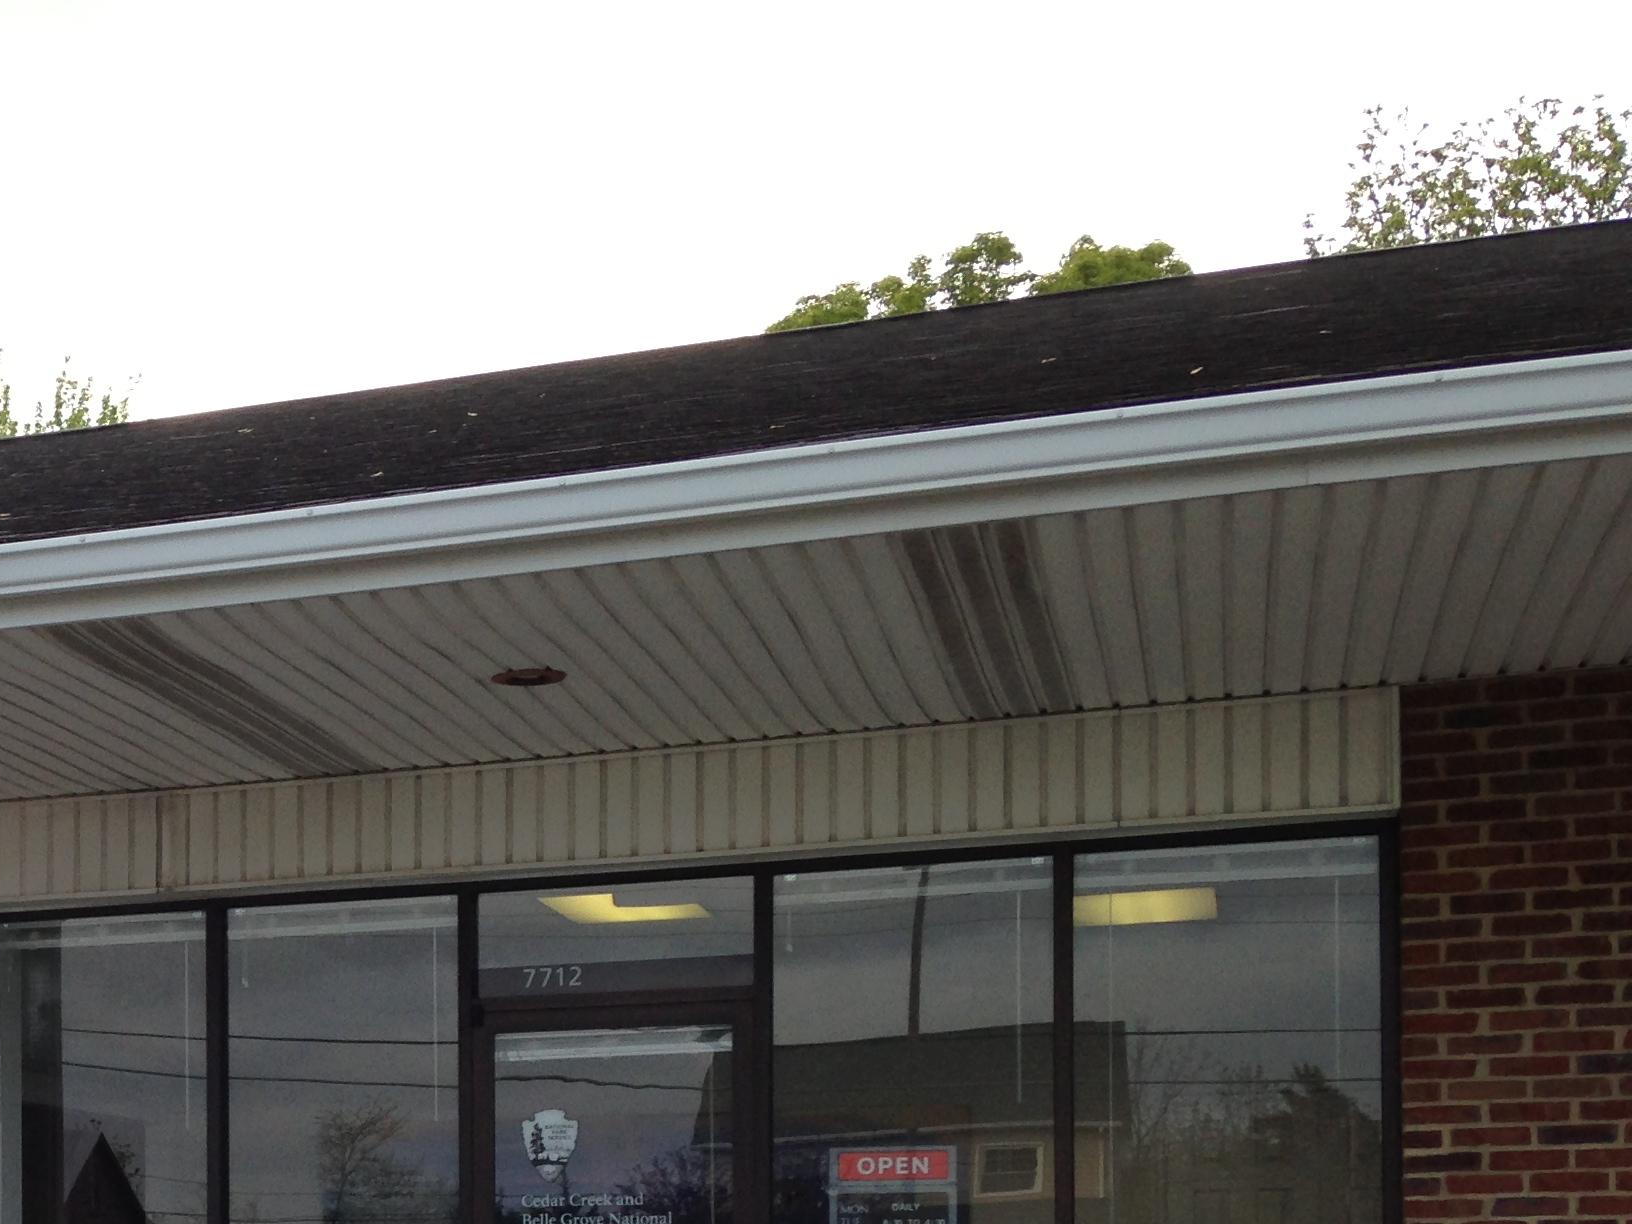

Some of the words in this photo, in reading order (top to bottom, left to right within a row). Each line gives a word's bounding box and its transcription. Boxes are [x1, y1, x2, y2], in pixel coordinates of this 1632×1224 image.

[523, 966, 582, 988] 7712
[857, 1157, 929, 1175] OPEN
[521, 1194, 566, 1208] Cedar
[569, 1194, 611, 1207] Creek
[616, 1193, 644, 1206] and
[891, 1203, 920, 1212] DAILY
[840, 1204, 869, 1214] MON
